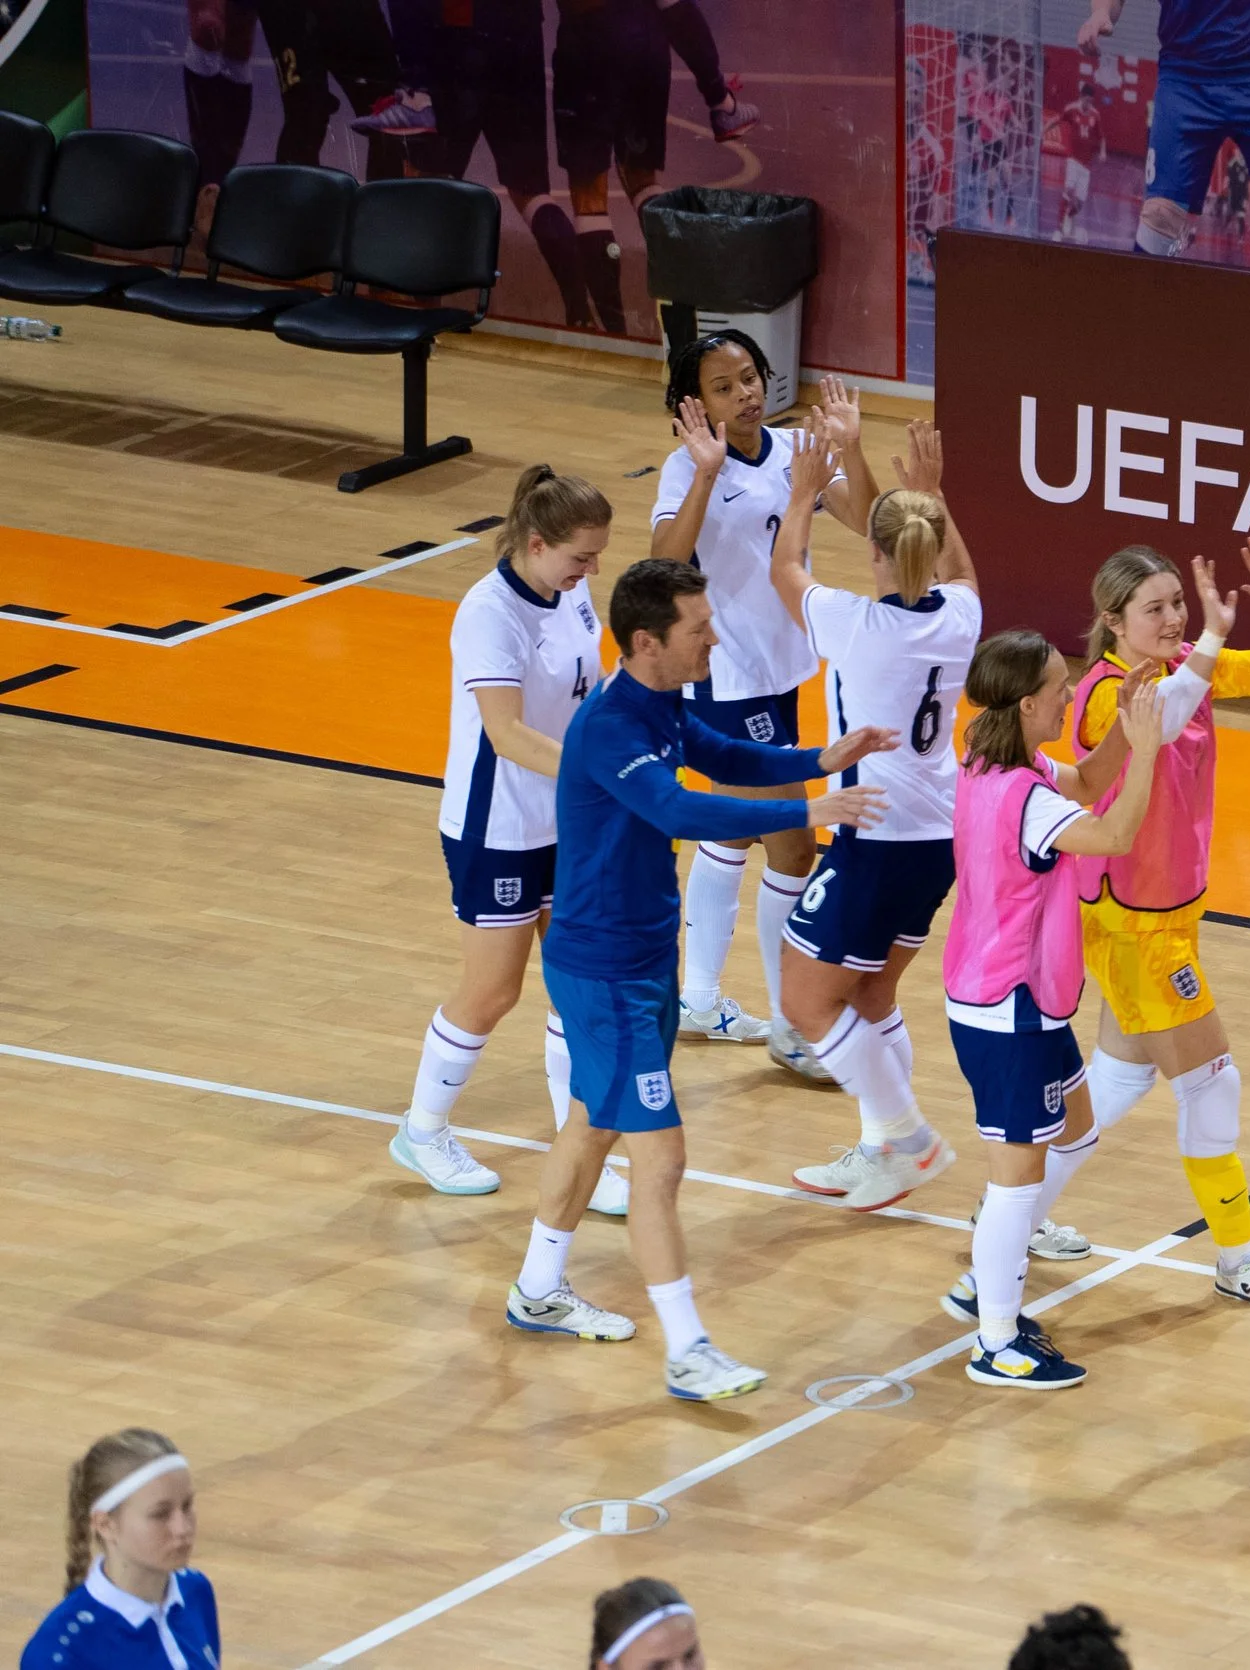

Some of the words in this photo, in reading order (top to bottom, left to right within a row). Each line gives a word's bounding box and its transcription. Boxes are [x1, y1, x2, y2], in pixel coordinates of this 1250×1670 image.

[571, 655, 588, 700] 4
[911, 664, 944, 757] 6
[801, 867, 837, 913] 6
